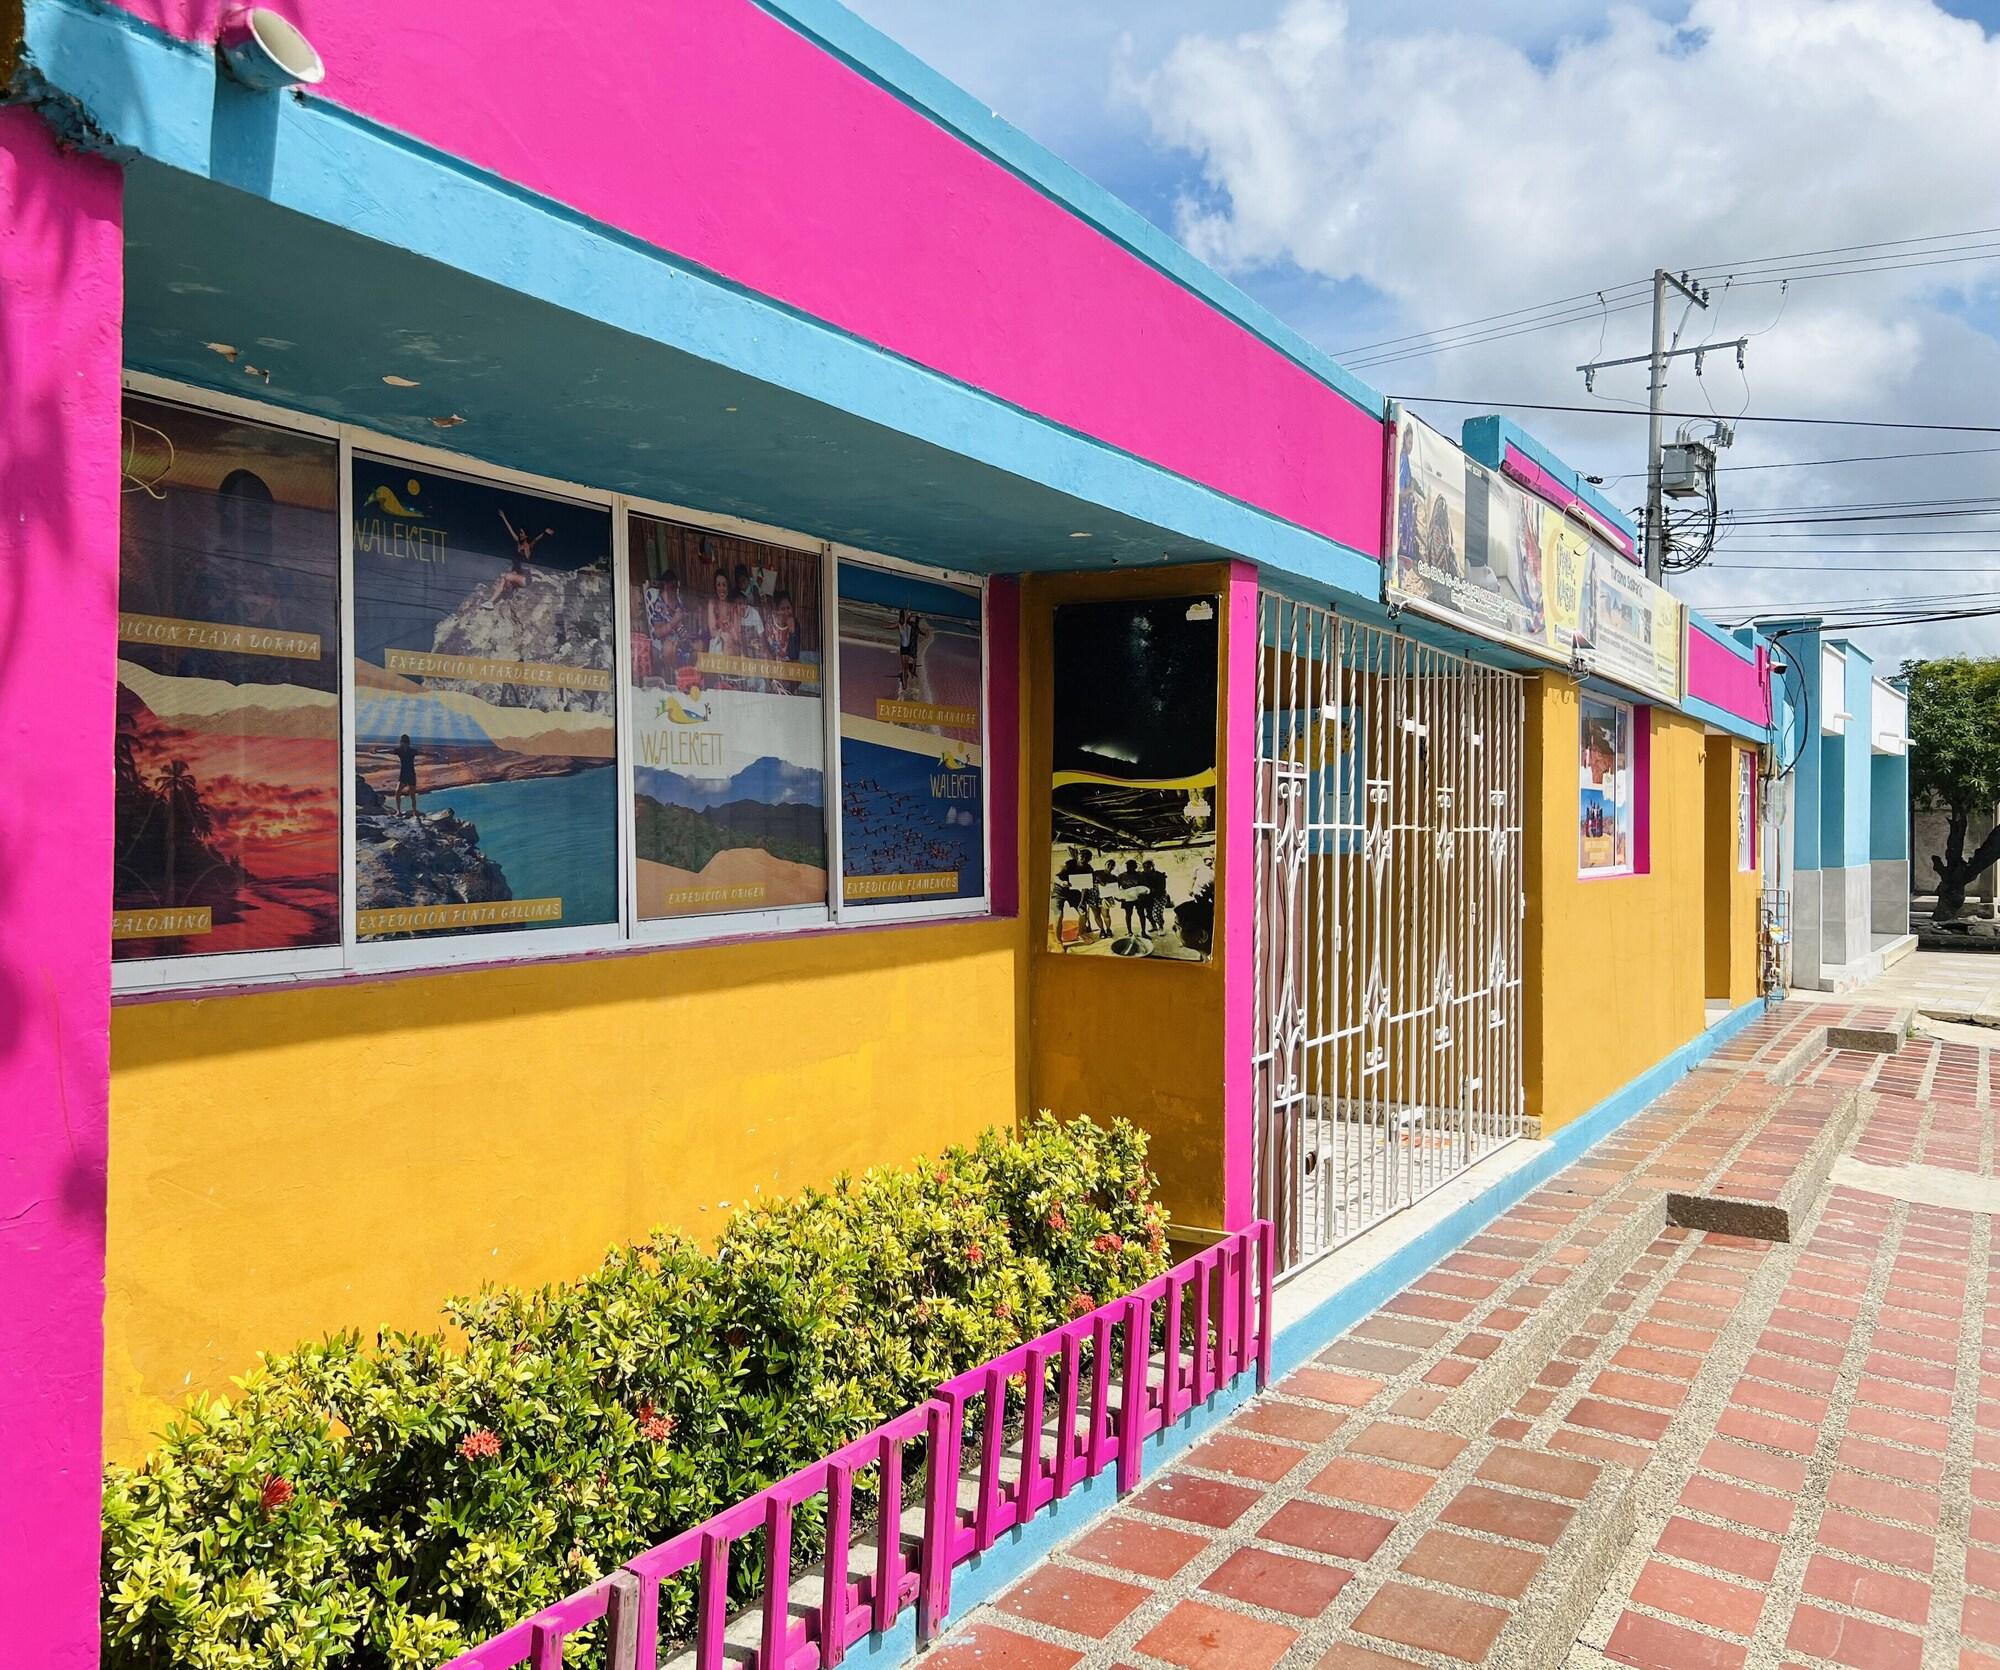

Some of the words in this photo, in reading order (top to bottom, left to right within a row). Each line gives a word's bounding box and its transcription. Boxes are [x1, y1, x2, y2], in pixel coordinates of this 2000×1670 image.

[187, 628, 240, 646] PLAYA
[250, 634, 319, 654] DORADA
[389, 655, 473, 675] EXPEDICION
[480, 665, 554, 682] ATARDECER
[880, 704, 933, 720] EXPEDICION
[847, 879, 903, 894] EXPEDICION
[907, 877, 957, 891] FLAMENCOS
[669, 889, 727, 904] EXPEDICION
[112, 914, 210, 932] PALOMINO
[359, 911, 447, 930] EXPEDICION
[453, 907, 496, 922] PUNTA
[501, 904, 560, 919] GALLINAS
